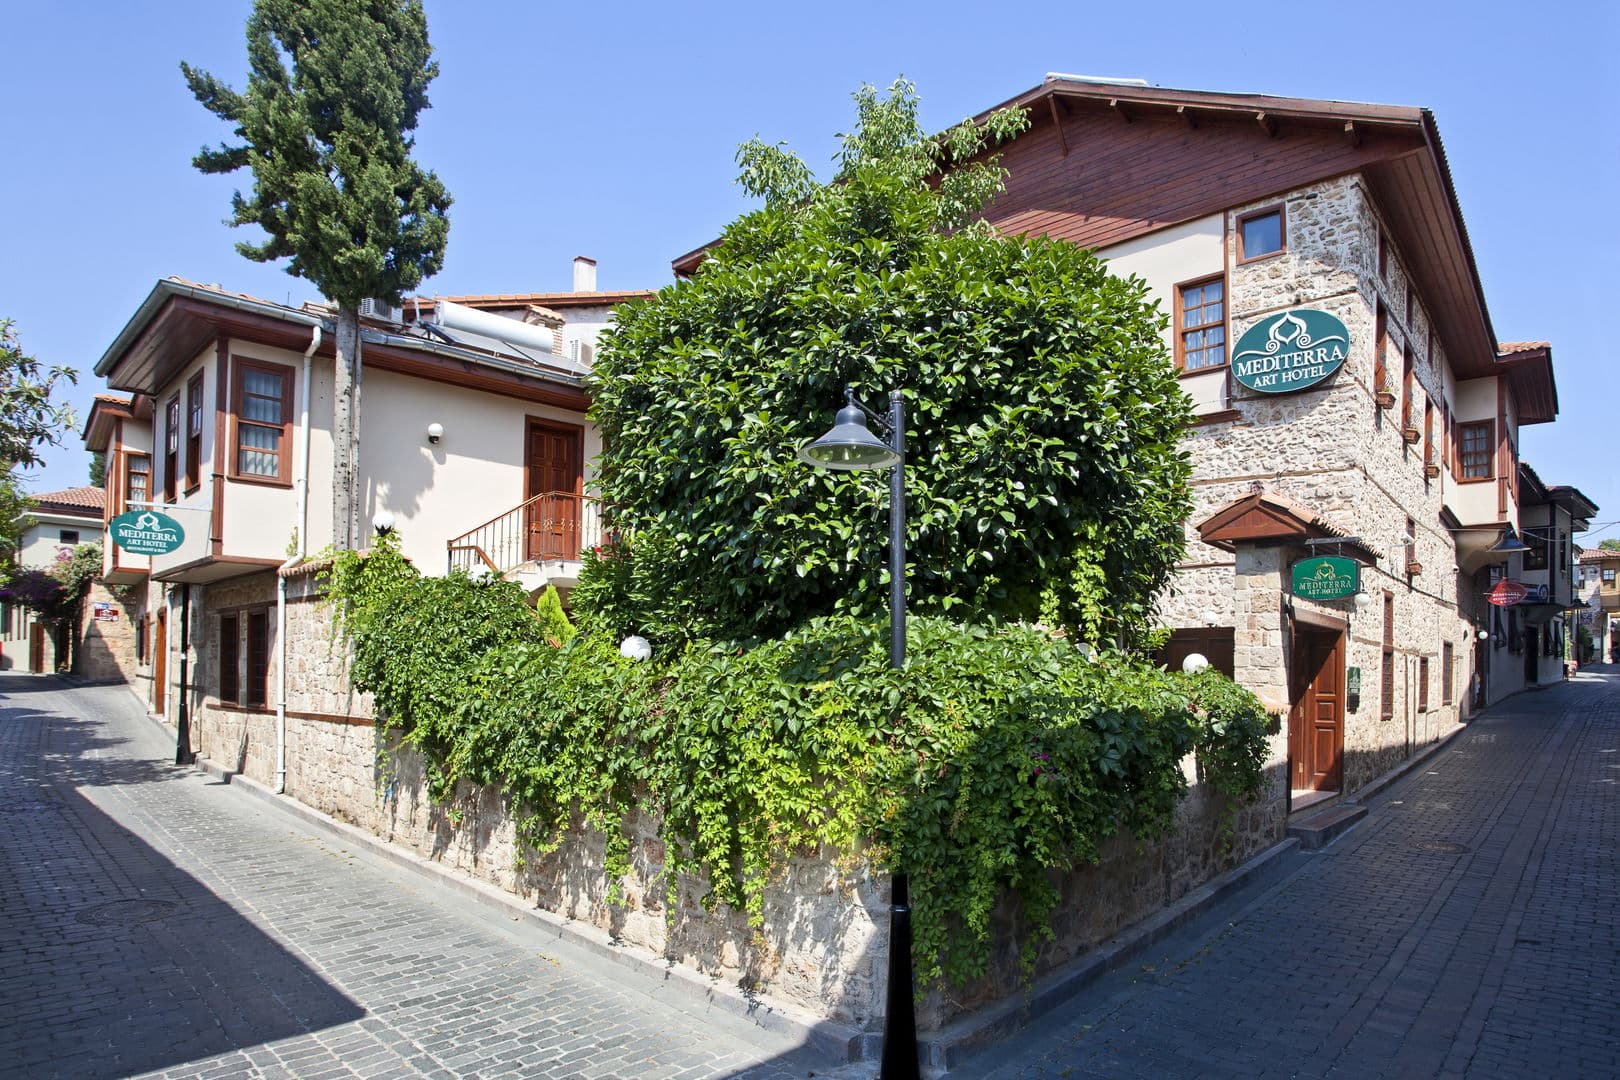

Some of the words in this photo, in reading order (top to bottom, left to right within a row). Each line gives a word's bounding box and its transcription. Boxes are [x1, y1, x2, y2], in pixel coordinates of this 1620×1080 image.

[1237, 345, 1344, 377] MEDITERRA
[1253, 373, 1278, 388] ART
[1281, 365, 1327, 383] HOTEL
[118, 529, 177, 542] MEDITERRA
[142, 540, 168, 548] HOTEL
[1299, 581, 1351, 591] MEDITERRA
